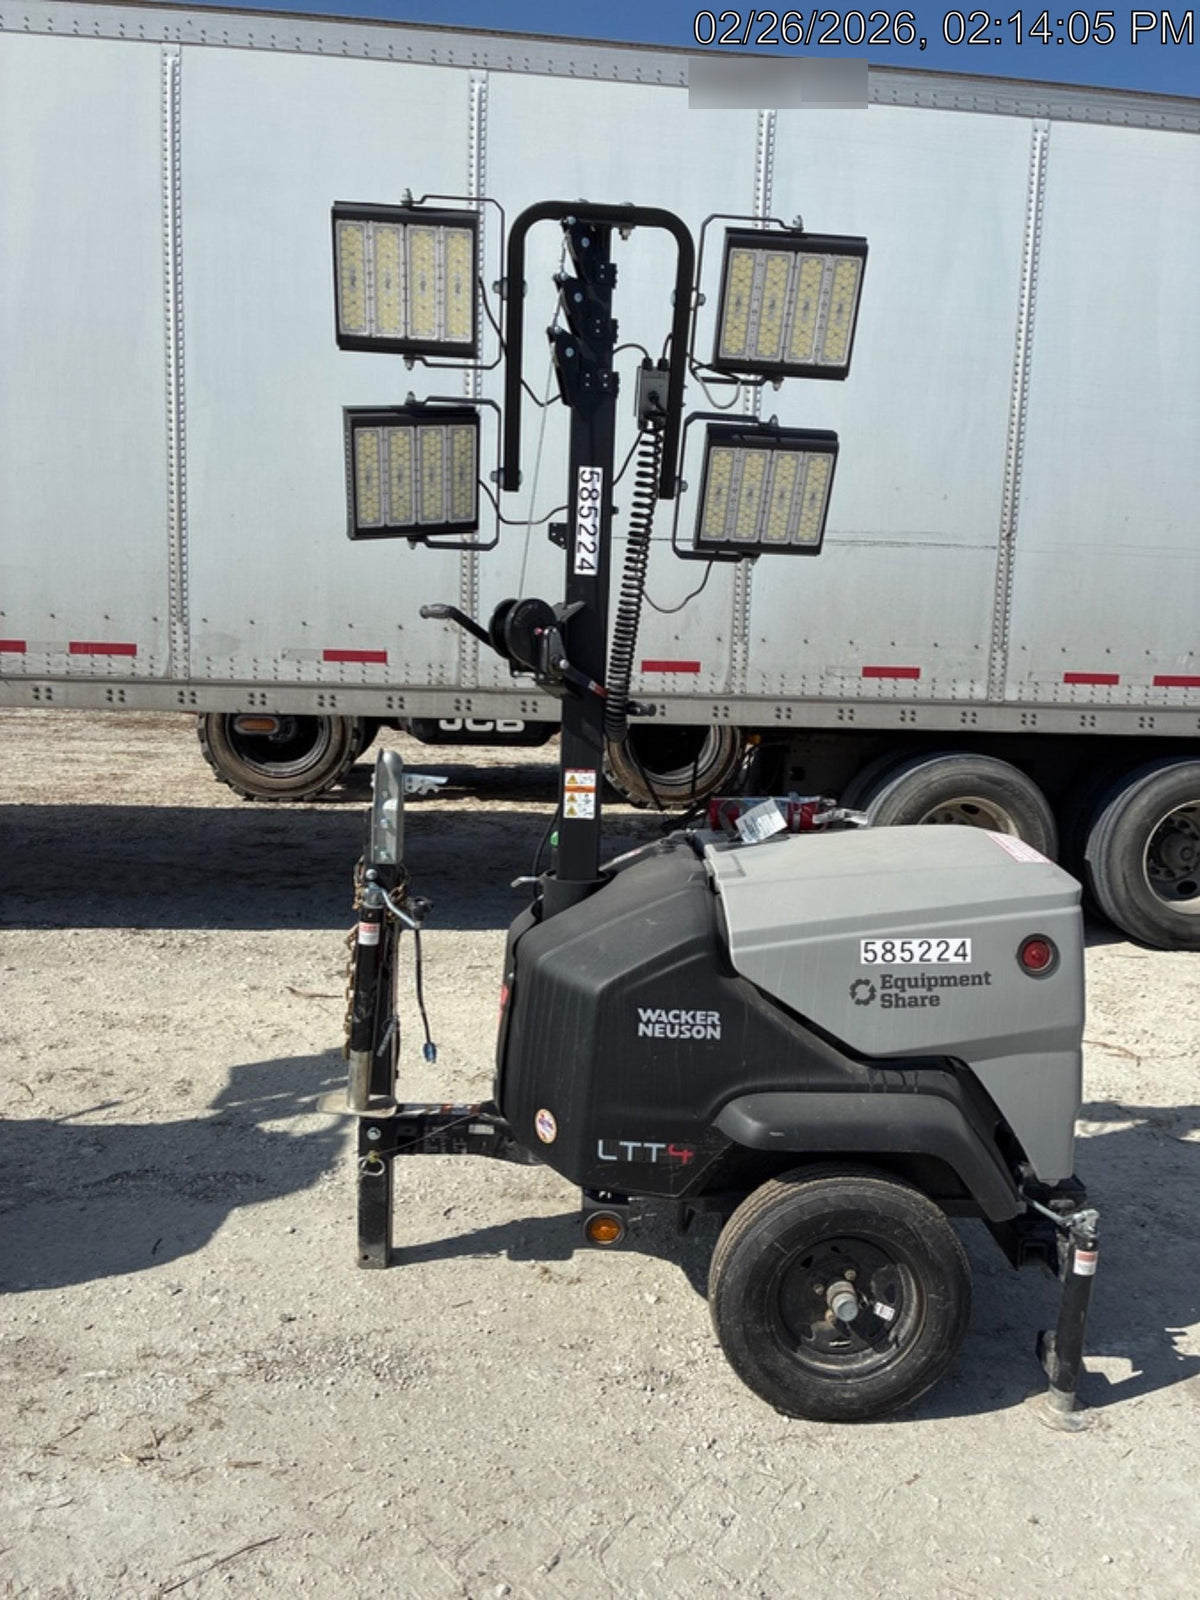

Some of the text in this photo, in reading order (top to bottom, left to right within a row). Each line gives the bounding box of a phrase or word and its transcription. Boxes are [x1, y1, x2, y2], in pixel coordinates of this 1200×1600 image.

[577, 470, 600, 571] 585224
[863, 940, 969, 963] 585224
[880, 971, 992, 992] Equipment
[880, 993, 941, 1009] Share
[637, 1007, 721, 1025] WACKER
[637, 1023, 721, 1040] NEUSON
[597, 1139, 694, 1165] LTT4
